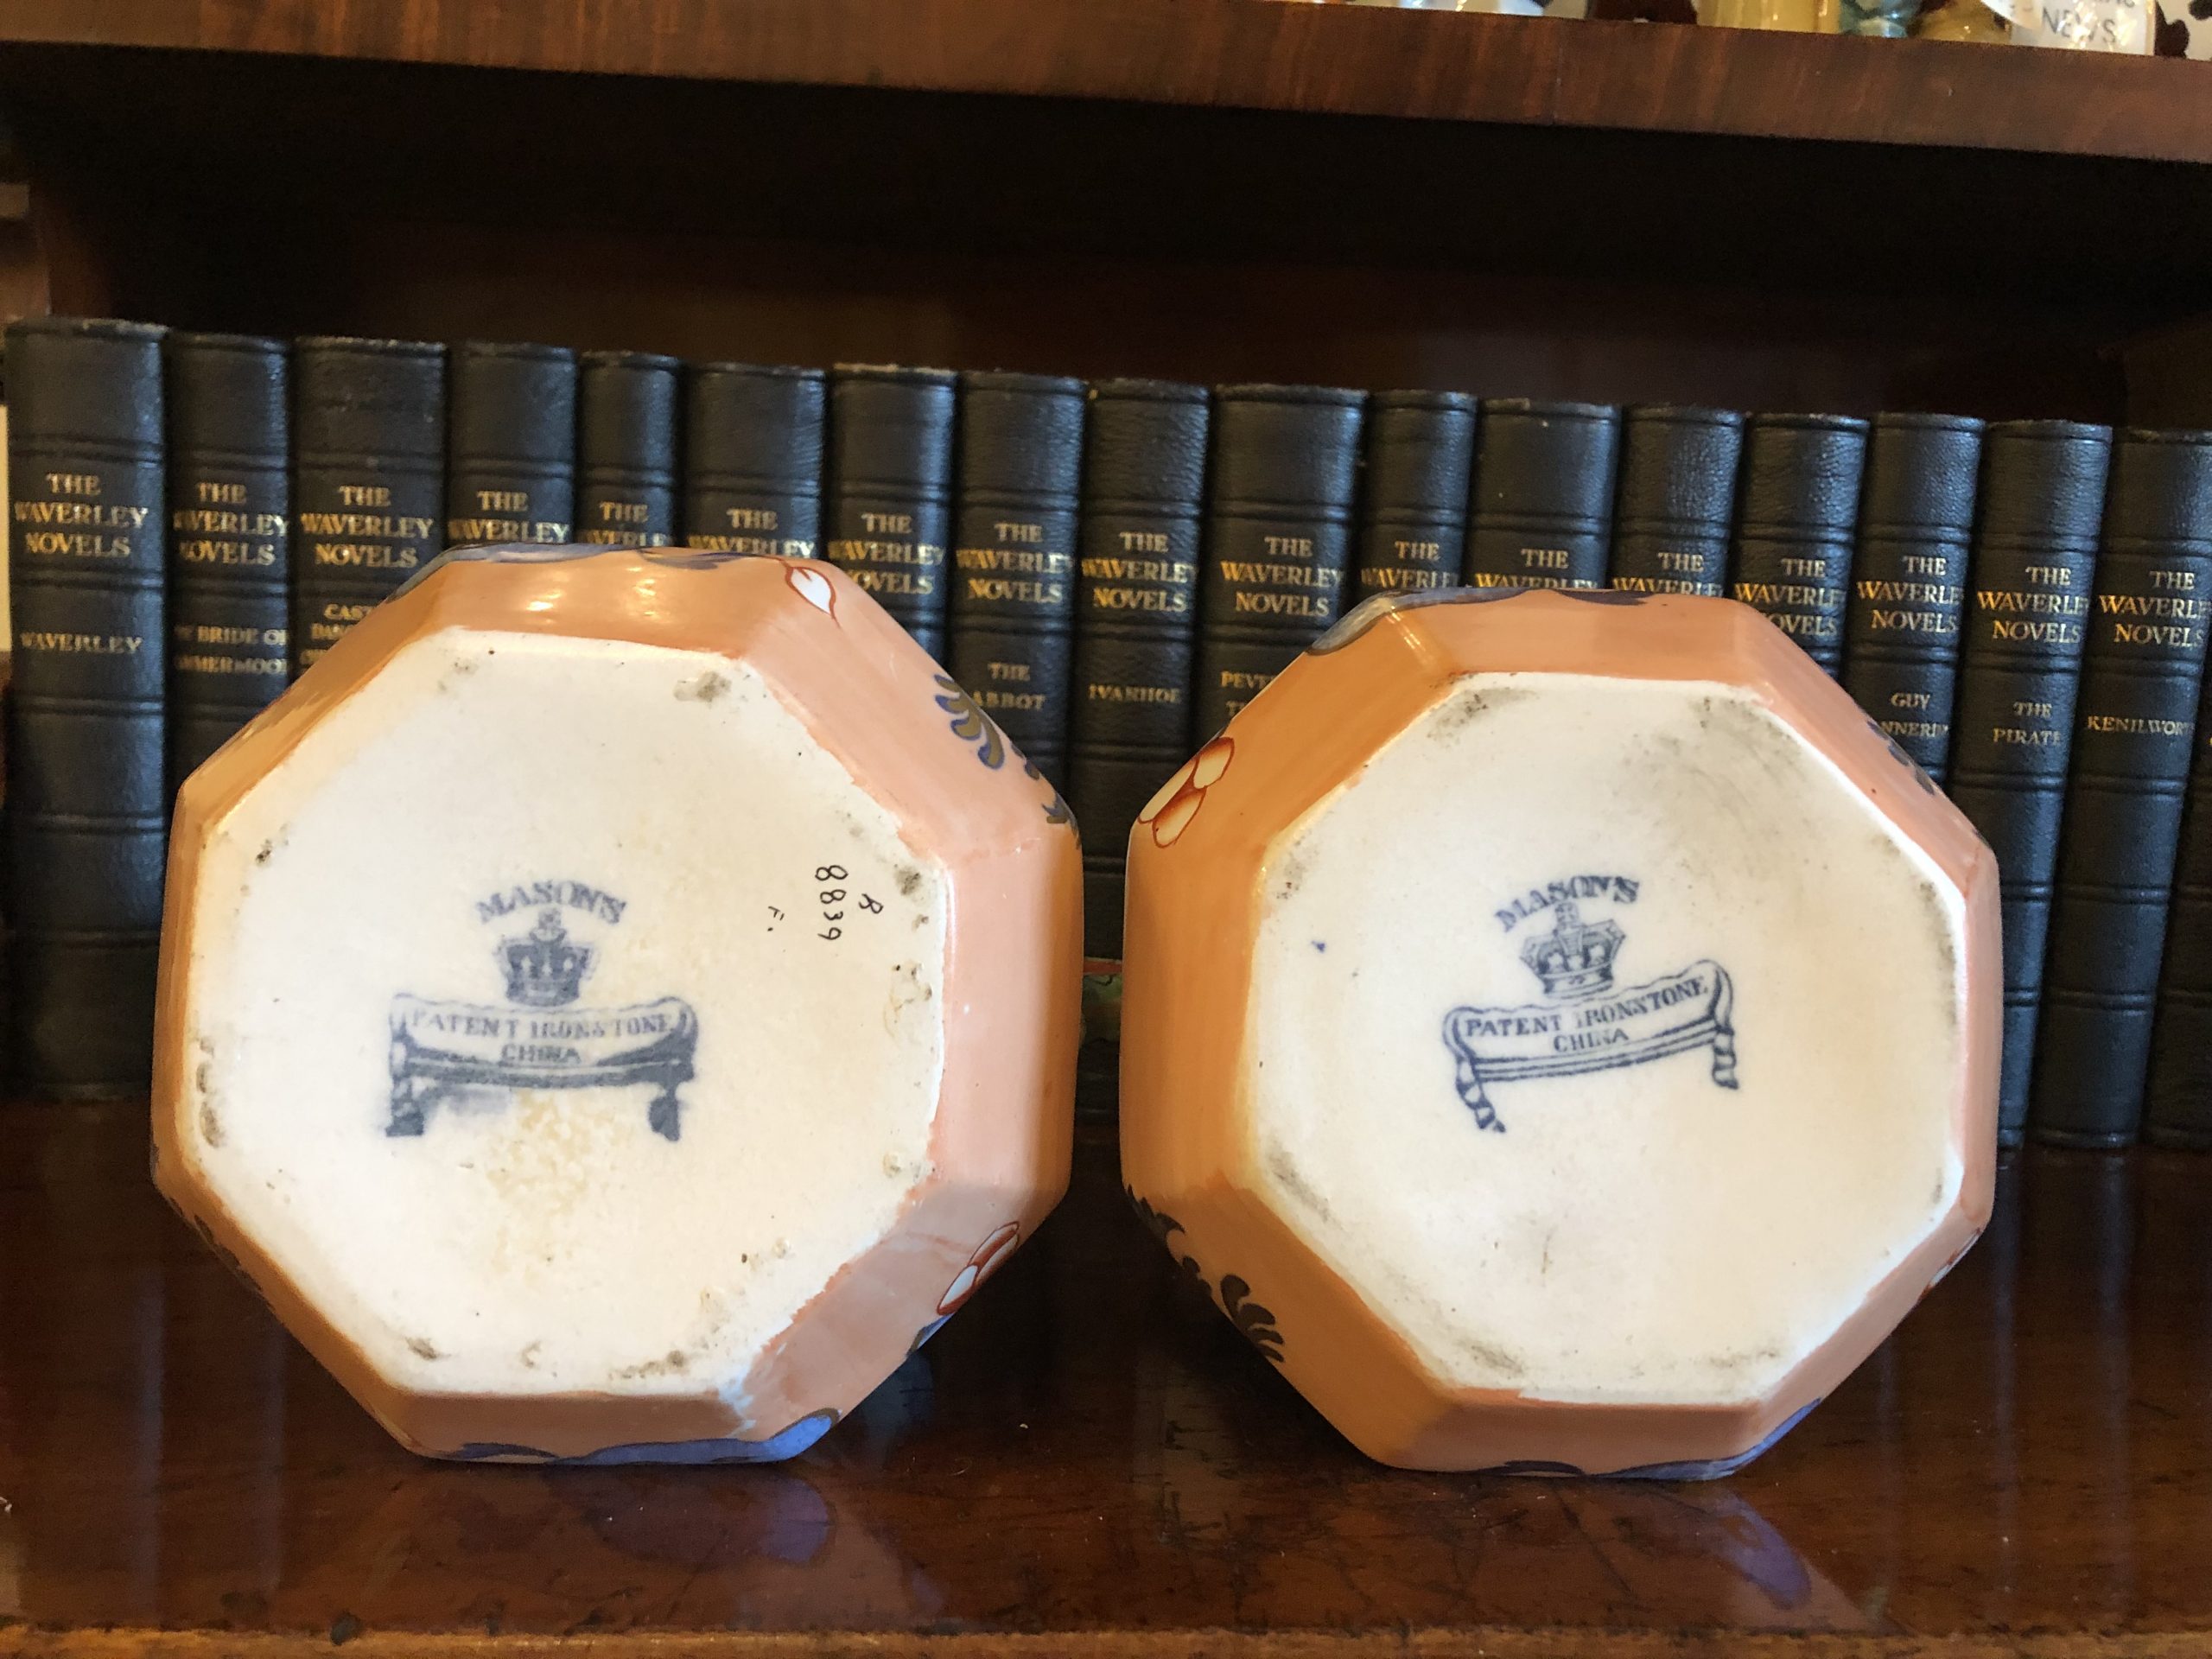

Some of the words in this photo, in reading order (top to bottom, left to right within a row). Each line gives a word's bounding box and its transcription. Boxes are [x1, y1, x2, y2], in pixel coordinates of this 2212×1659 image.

[47, 473, 101, 496] THE
[196, 482, 247, 504] THE
[340, 486, 391, 507] THE
[477, 491, 528, 512] THE
[14, 501, 149, 529] WAVERLEY
[600, 501, 648, 523] THE
[727, 508, 779, 531] THE
[861, 513, 912, 534] THE
[300, 512, 433, 539] WAVERLEY
[995, 523, 1043, 543] THE
[25, 532, 131, 557] NOVELS
[1119, 531, 1169, 553] THE
[1264, 536, 1313, 557] THE
[1395, 540, 1440, 561] THE
[315, 543, 418, 569] NOVELS
[1521, 548, 1569, 569] THE
[1658, 552, 1705, 572] THE
[1780, 557, 1826, 578] THE
[1903, 556, 1947, 576] THE
[847, 569, 934, 594] OVELS
[2025, 566, 2071, 586] THE
[2150, 570, 2195, 590] THE
[968, 577, 1063, 603] NOVELS
[1093, 587, 1187, 613] NOVELS
[1734, 582, 1847, 607] WAVERLE
[1857, 581, 1963, 605] WAVERLE
[1236, 591, 1330, 617] NOVELS
[1977, 591, 2088, 615] WAVERLE
[2099, 594, 2212, 620] WAVERLE
[1763, 612, 1838, 637] OVELS
[1871, 608, 1959, 633] NOVELS
[1993, 620, 2081, 644] NOVELS
[20, 632, 142, 654] WAVERLEY
[2113, 622, 2204, 647] NOVELS
[988, 662, 1031, 682] THE
[1891, 692, 1931, 711] GUY
[2013, 701, 2053, 720] THE
[815, 864, 849, 941] 8839
[1464, 1013, 1563, 1038] PATENT
[1575, 975, 1709, 1030] IRONSTONE
[411, 1008, 519, 1039] PATENT
[1552, 1027, 1630, 1054] CHINA
[501, 1043, 582, 1068] CHINA
